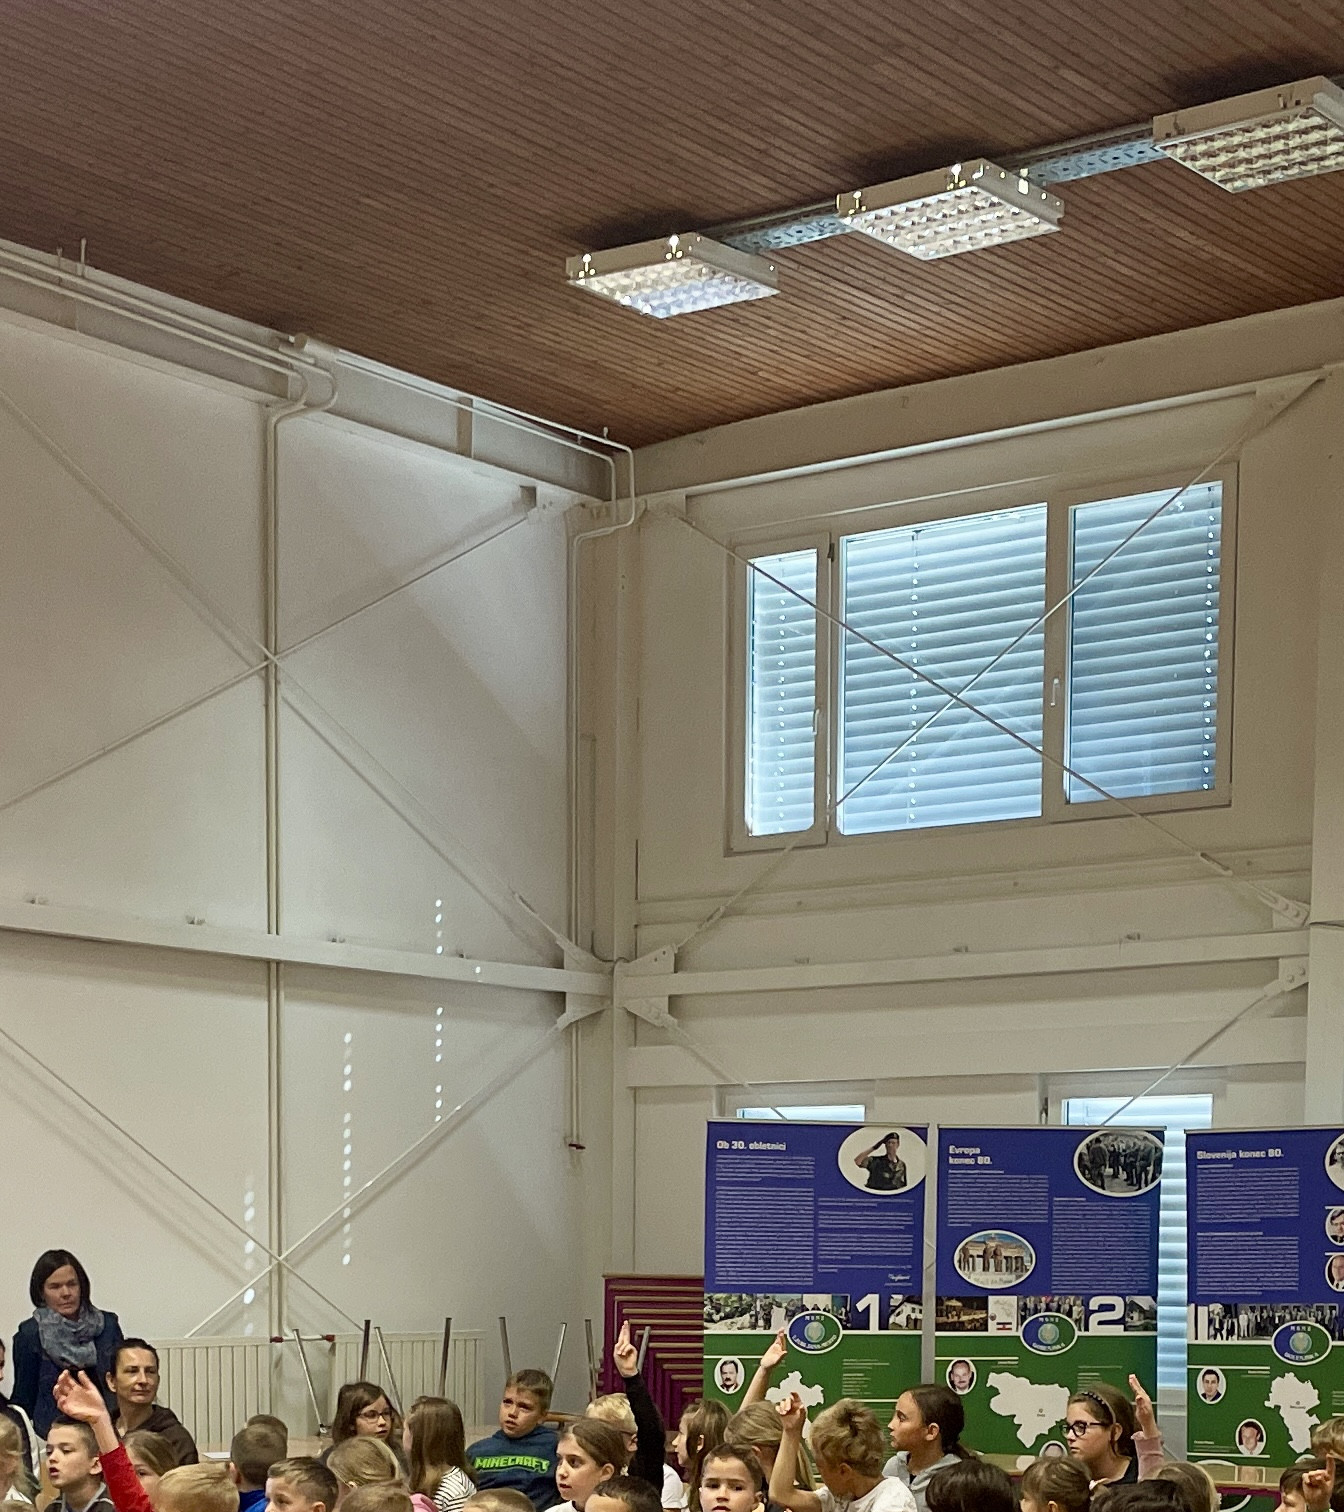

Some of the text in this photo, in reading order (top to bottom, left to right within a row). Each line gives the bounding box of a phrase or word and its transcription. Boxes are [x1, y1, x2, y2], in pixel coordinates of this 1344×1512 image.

[716, 1141, 729, 1149] Ob
[731, 1141, 747, 1149] 30.
[949, 1145, 981, 1156] Evropa
[949, 1156, 975, 1165] konec
[1196, 1150, 1237, 1160] Slovenija
[1239, 1150, 1266, 1158] konec
[856, 1294, 879, 1333] 1
[1089, 1296, 1125, 1333] 2
[474, 1455, 550, 1471] MINECRAFT
